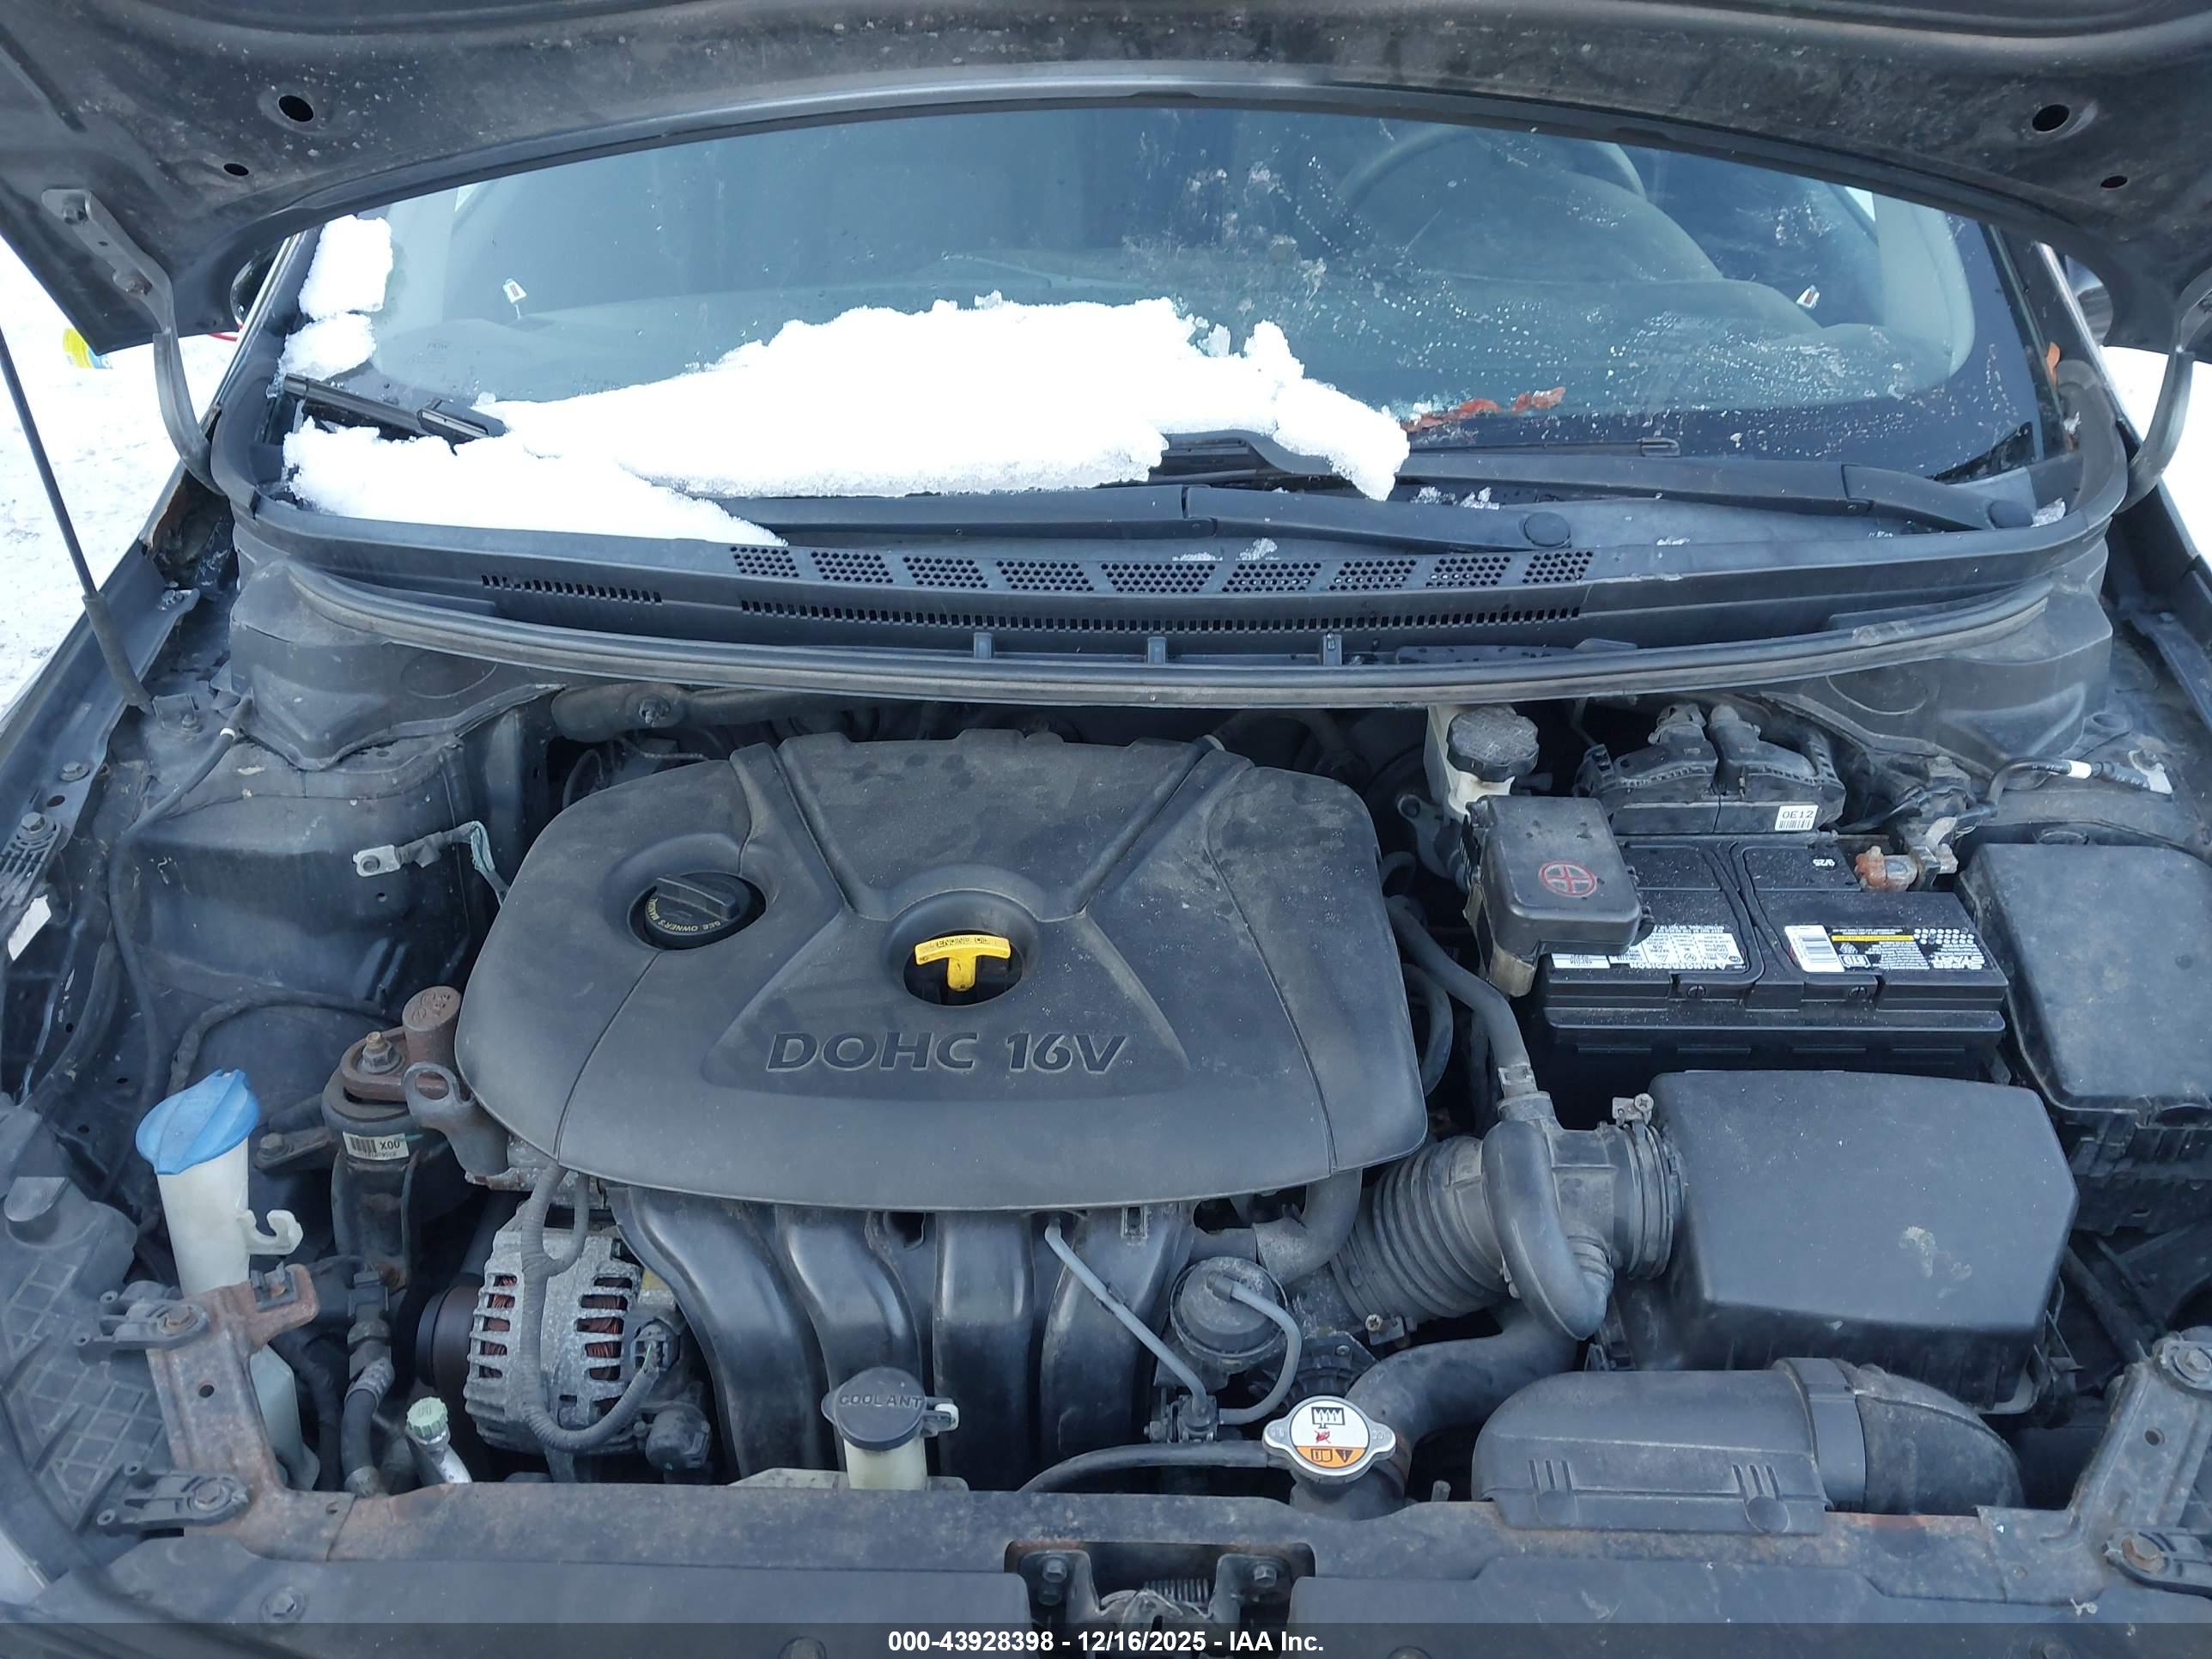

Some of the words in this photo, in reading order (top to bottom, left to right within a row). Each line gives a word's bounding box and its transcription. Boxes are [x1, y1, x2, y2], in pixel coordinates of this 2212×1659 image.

[766, 1031, 979, 1072] DOHC
[1006, 1032, 1128, 1073] 16V
[839, 1394, 923, 1409] COOLANT
